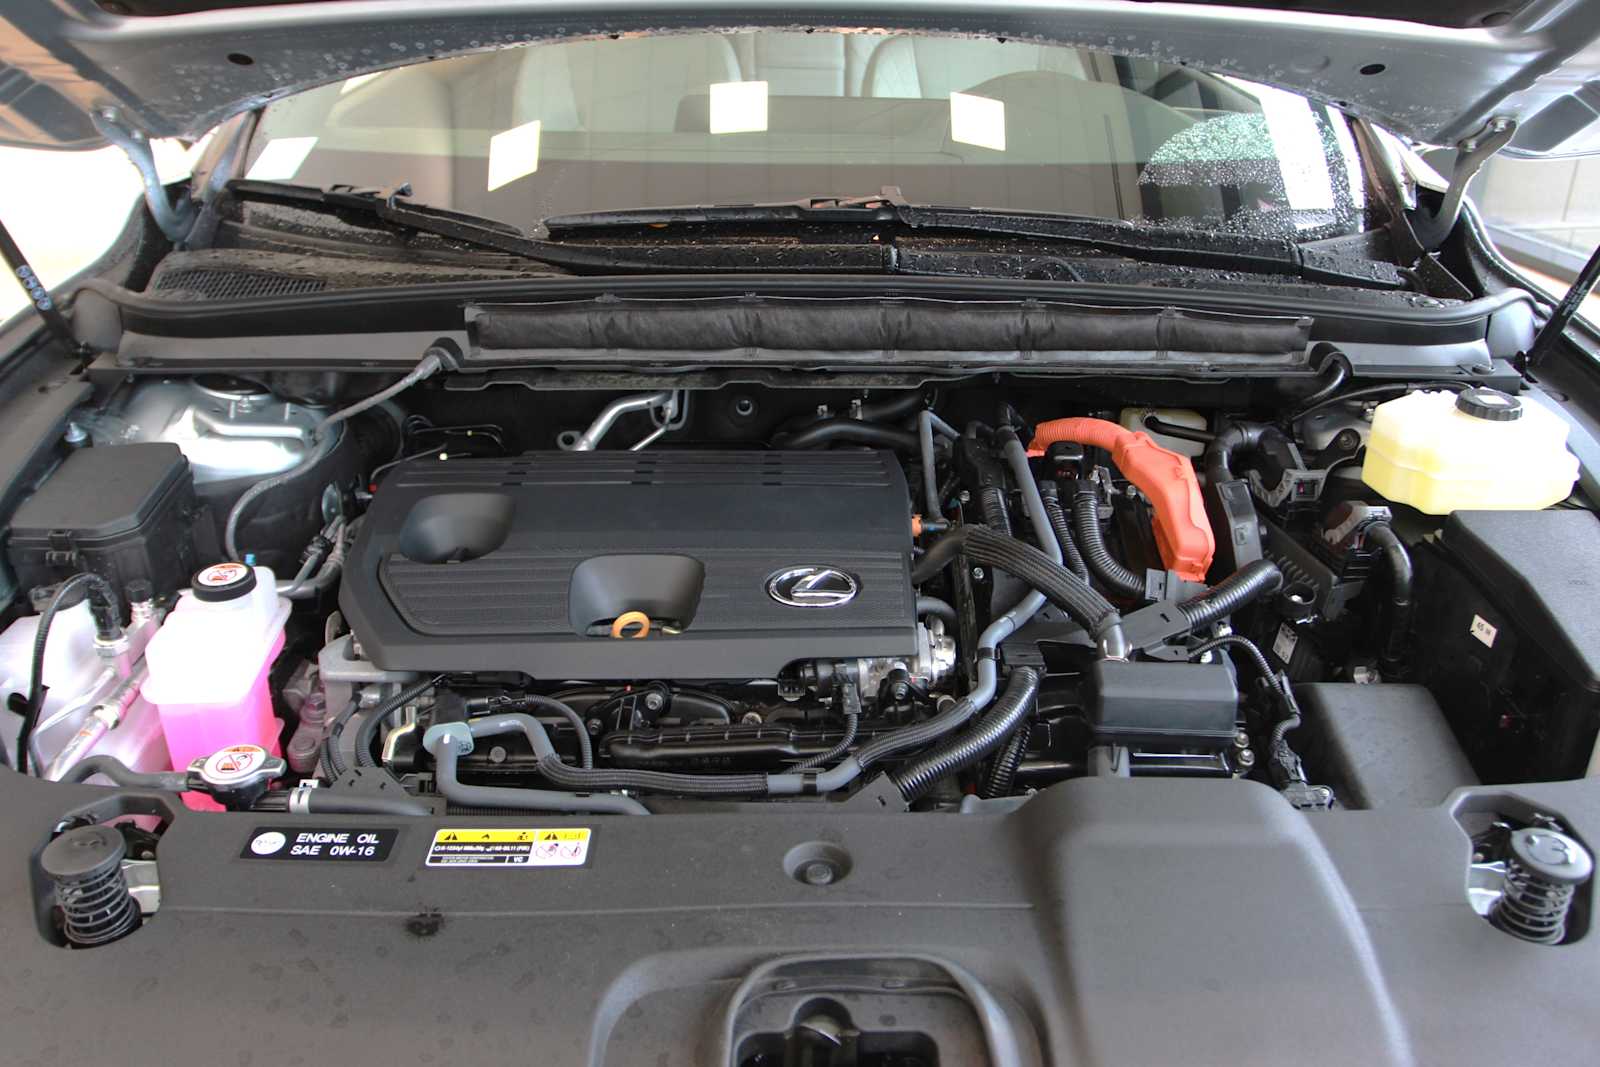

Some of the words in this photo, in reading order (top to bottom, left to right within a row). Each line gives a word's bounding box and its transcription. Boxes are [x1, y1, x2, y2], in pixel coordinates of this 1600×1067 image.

[296, 832, 350, 844] ENGINE
[356, 833, 380, 844] OIL
[290, 845, 322, 856] SAE
[329, 846, 376, 857] 0W-16
